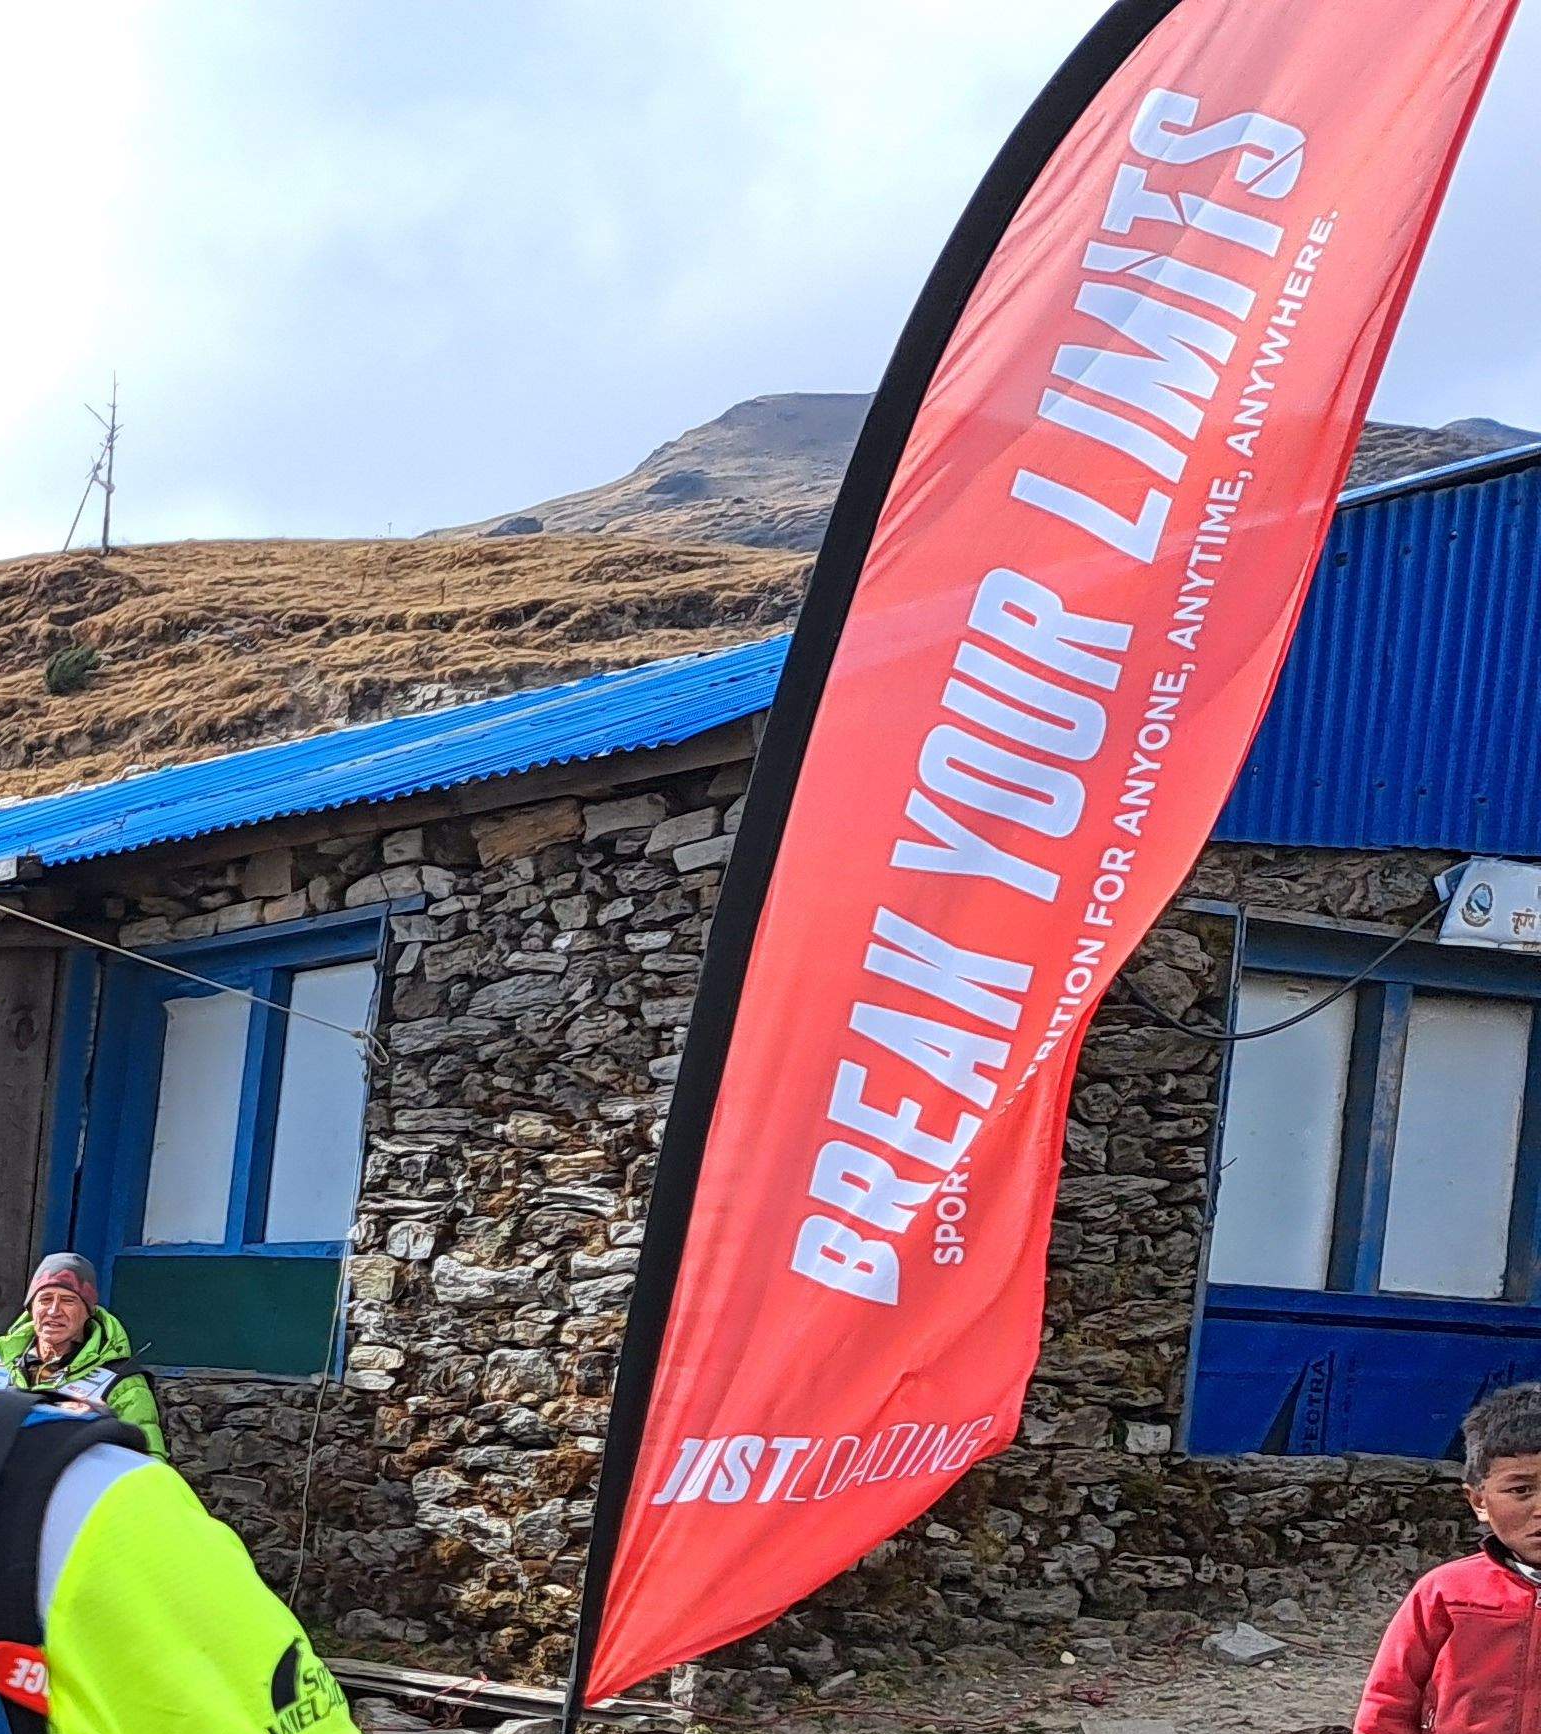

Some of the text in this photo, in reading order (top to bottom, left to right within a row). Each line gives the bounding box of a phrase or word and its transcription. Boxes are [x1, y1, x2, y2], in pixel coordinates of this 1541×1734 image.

[790, 87, 1308, 1306] BREAK YOUR LIMITS
[1084, 845, 1137, 928] FOR
[1113, 658, 1196, 836] ANYONE,
[1167, 465, 1253, 651] ANYTIME,
[1235, 209, 1340, 459] ANYWHERE.
